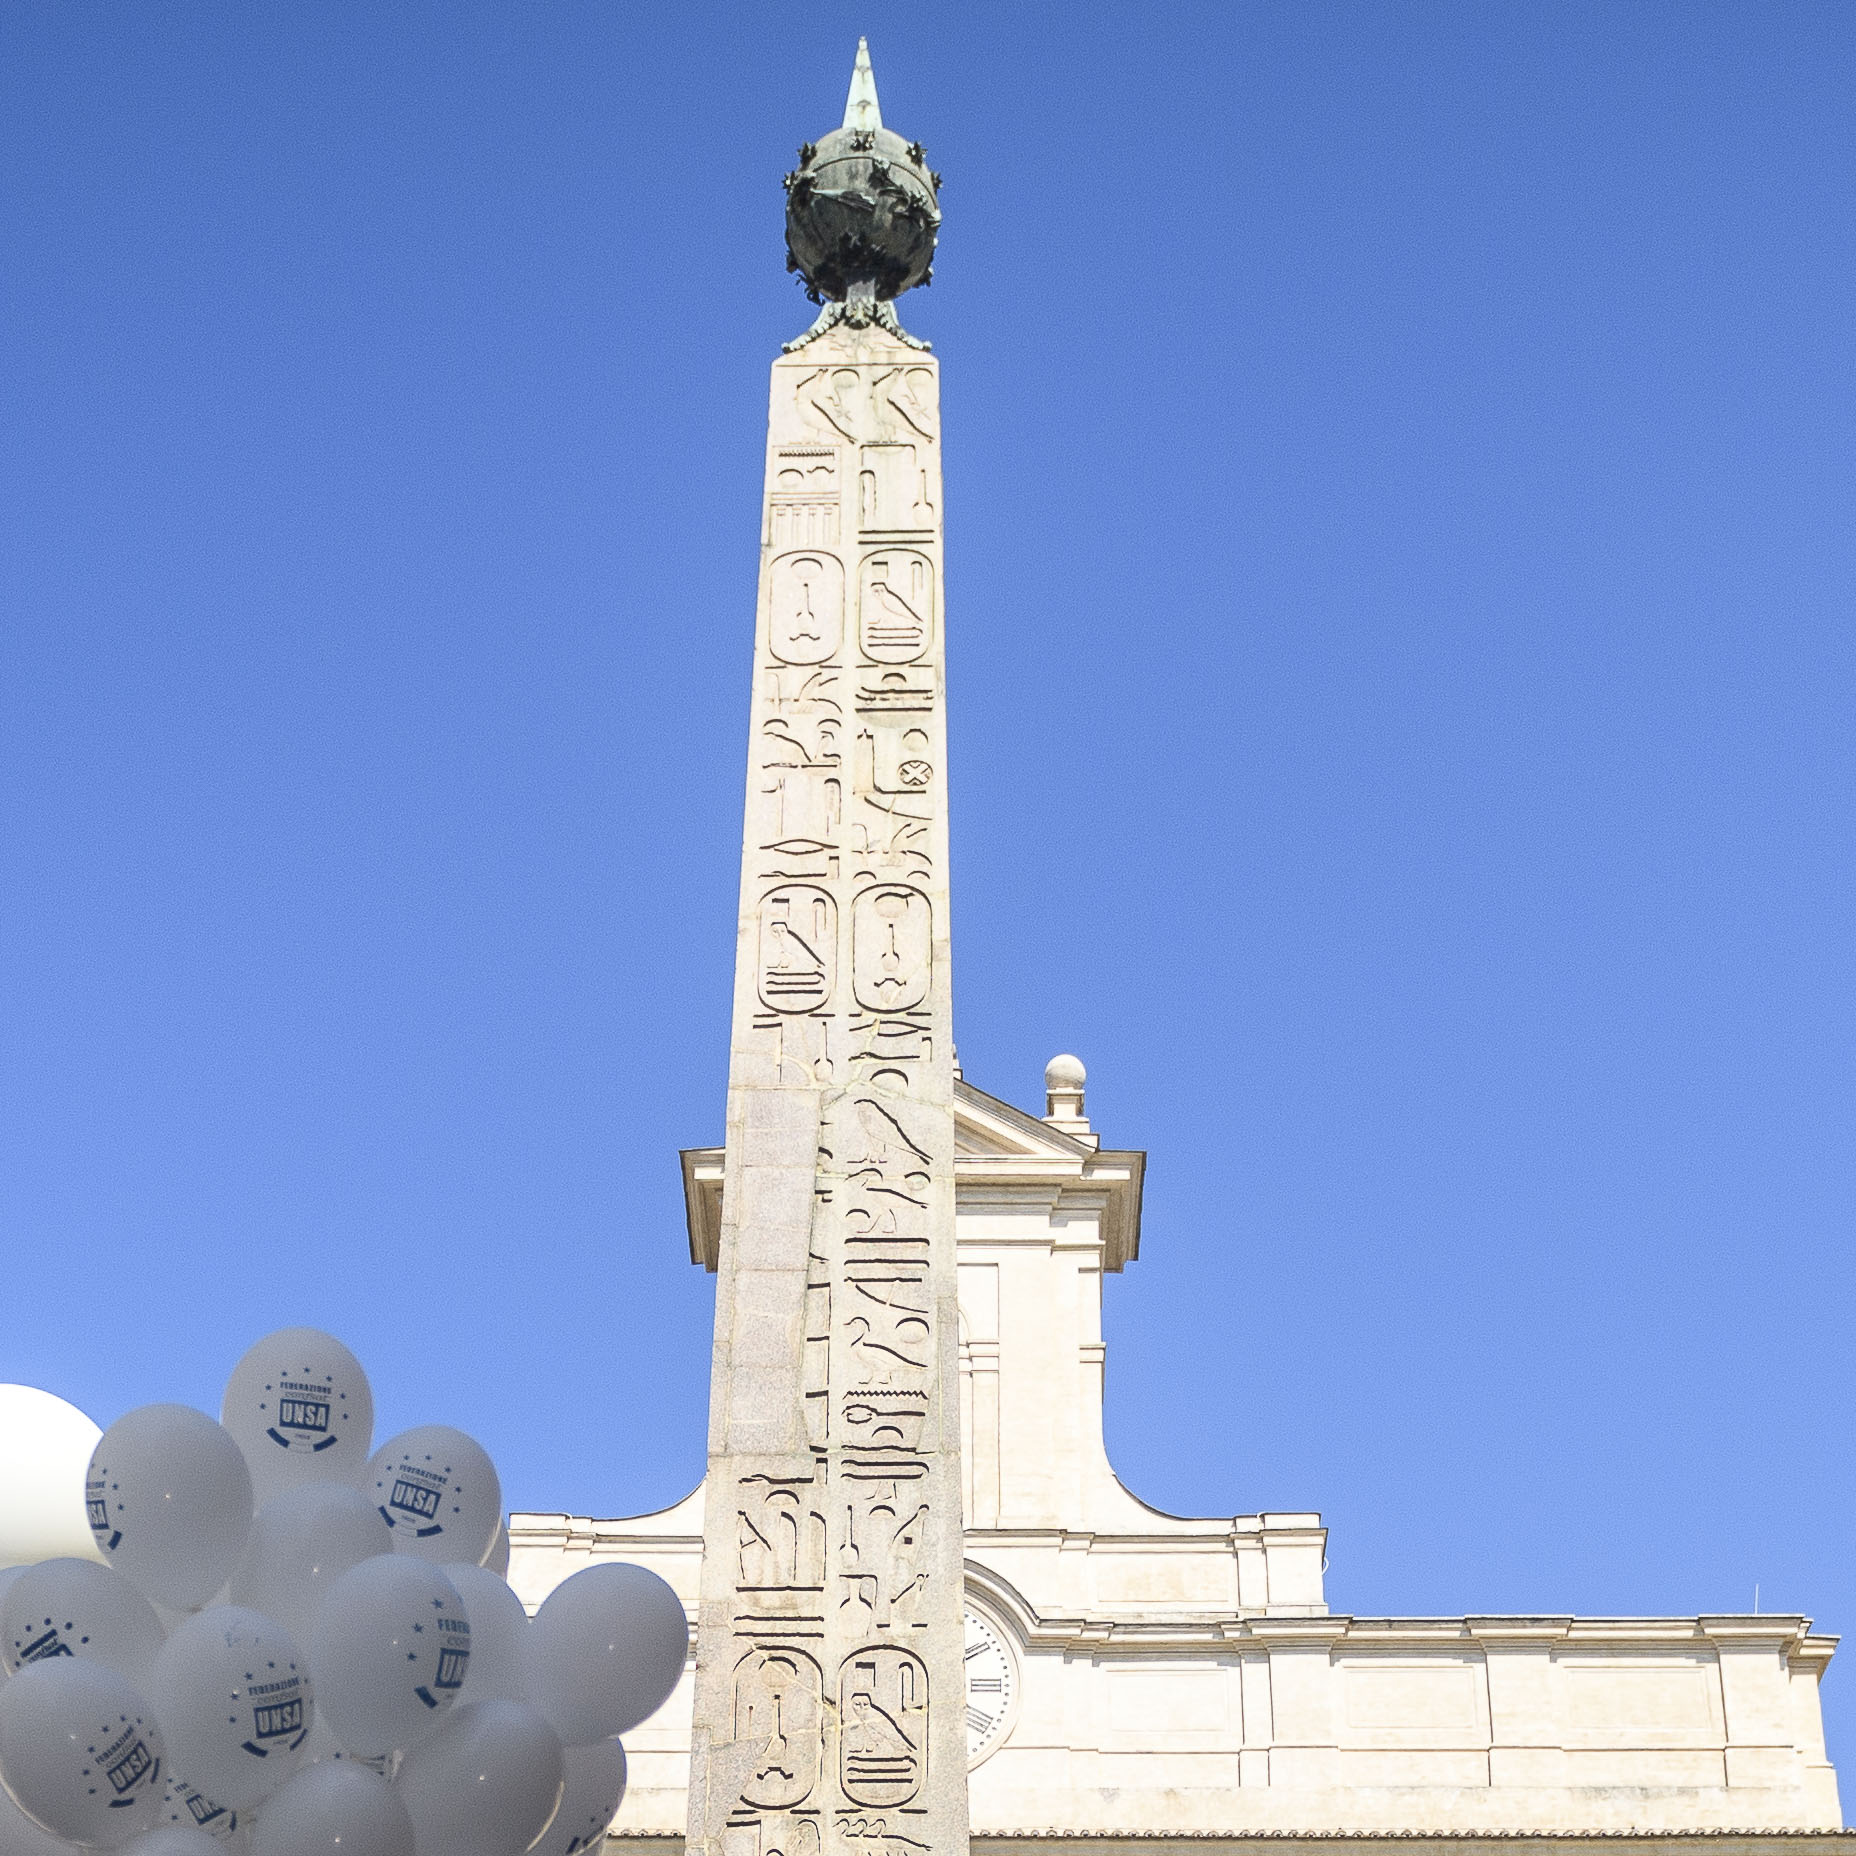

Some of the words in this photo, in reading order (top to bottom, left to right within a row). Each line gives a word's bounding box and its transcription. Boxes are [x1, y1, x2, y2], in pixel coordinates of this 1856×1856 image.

[281, 1402, 328, 1427] UNSA
[394, 1483, 439, 1516] UNSA
[256, 1701, 302, 1735] UNSA
[108, 1744, 151, 1793] UNSA
